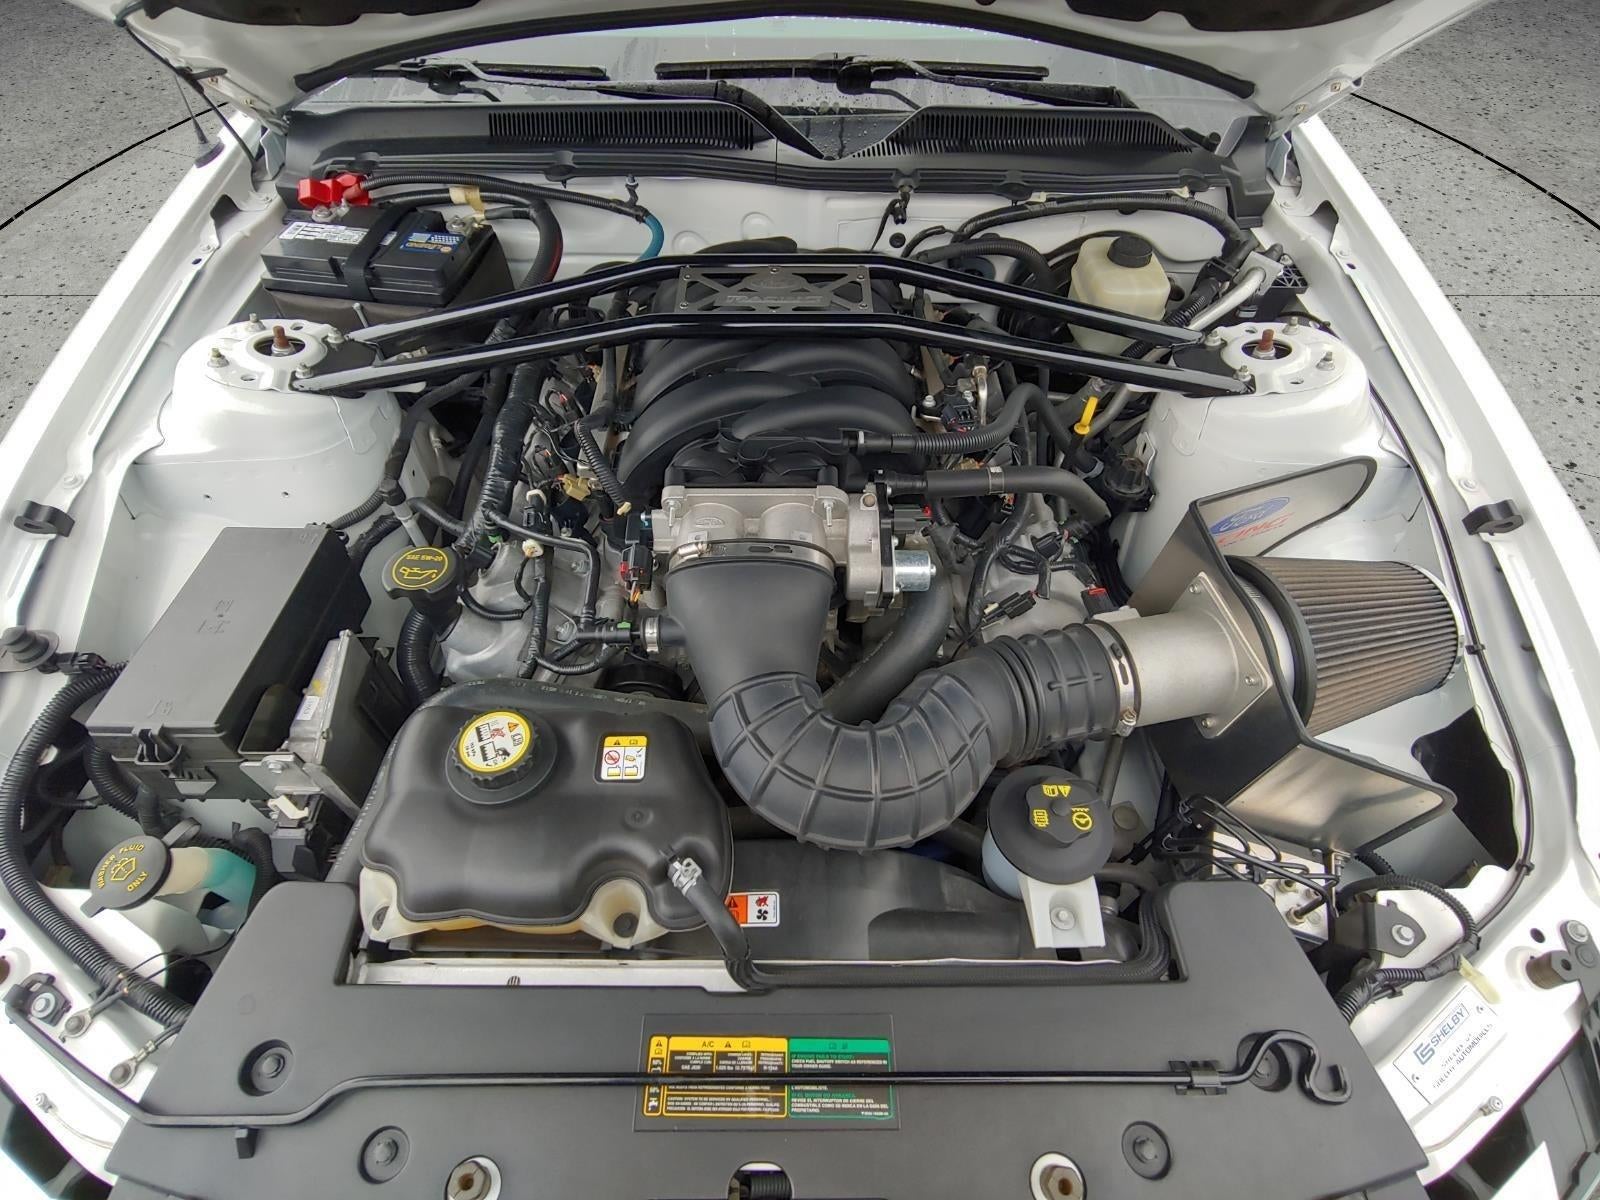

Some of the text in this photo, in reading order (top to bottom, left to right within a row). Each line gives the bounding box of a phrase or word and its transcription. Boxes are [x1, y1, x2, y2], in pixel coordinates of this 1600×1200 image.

[420, 554, 443, 562] 5W-20
[97, 843, 145, 889] WASHER FLUID
[127, 871, 149, 893] ONLY
[1430, 1007, 1467, 1047] SHELBY
